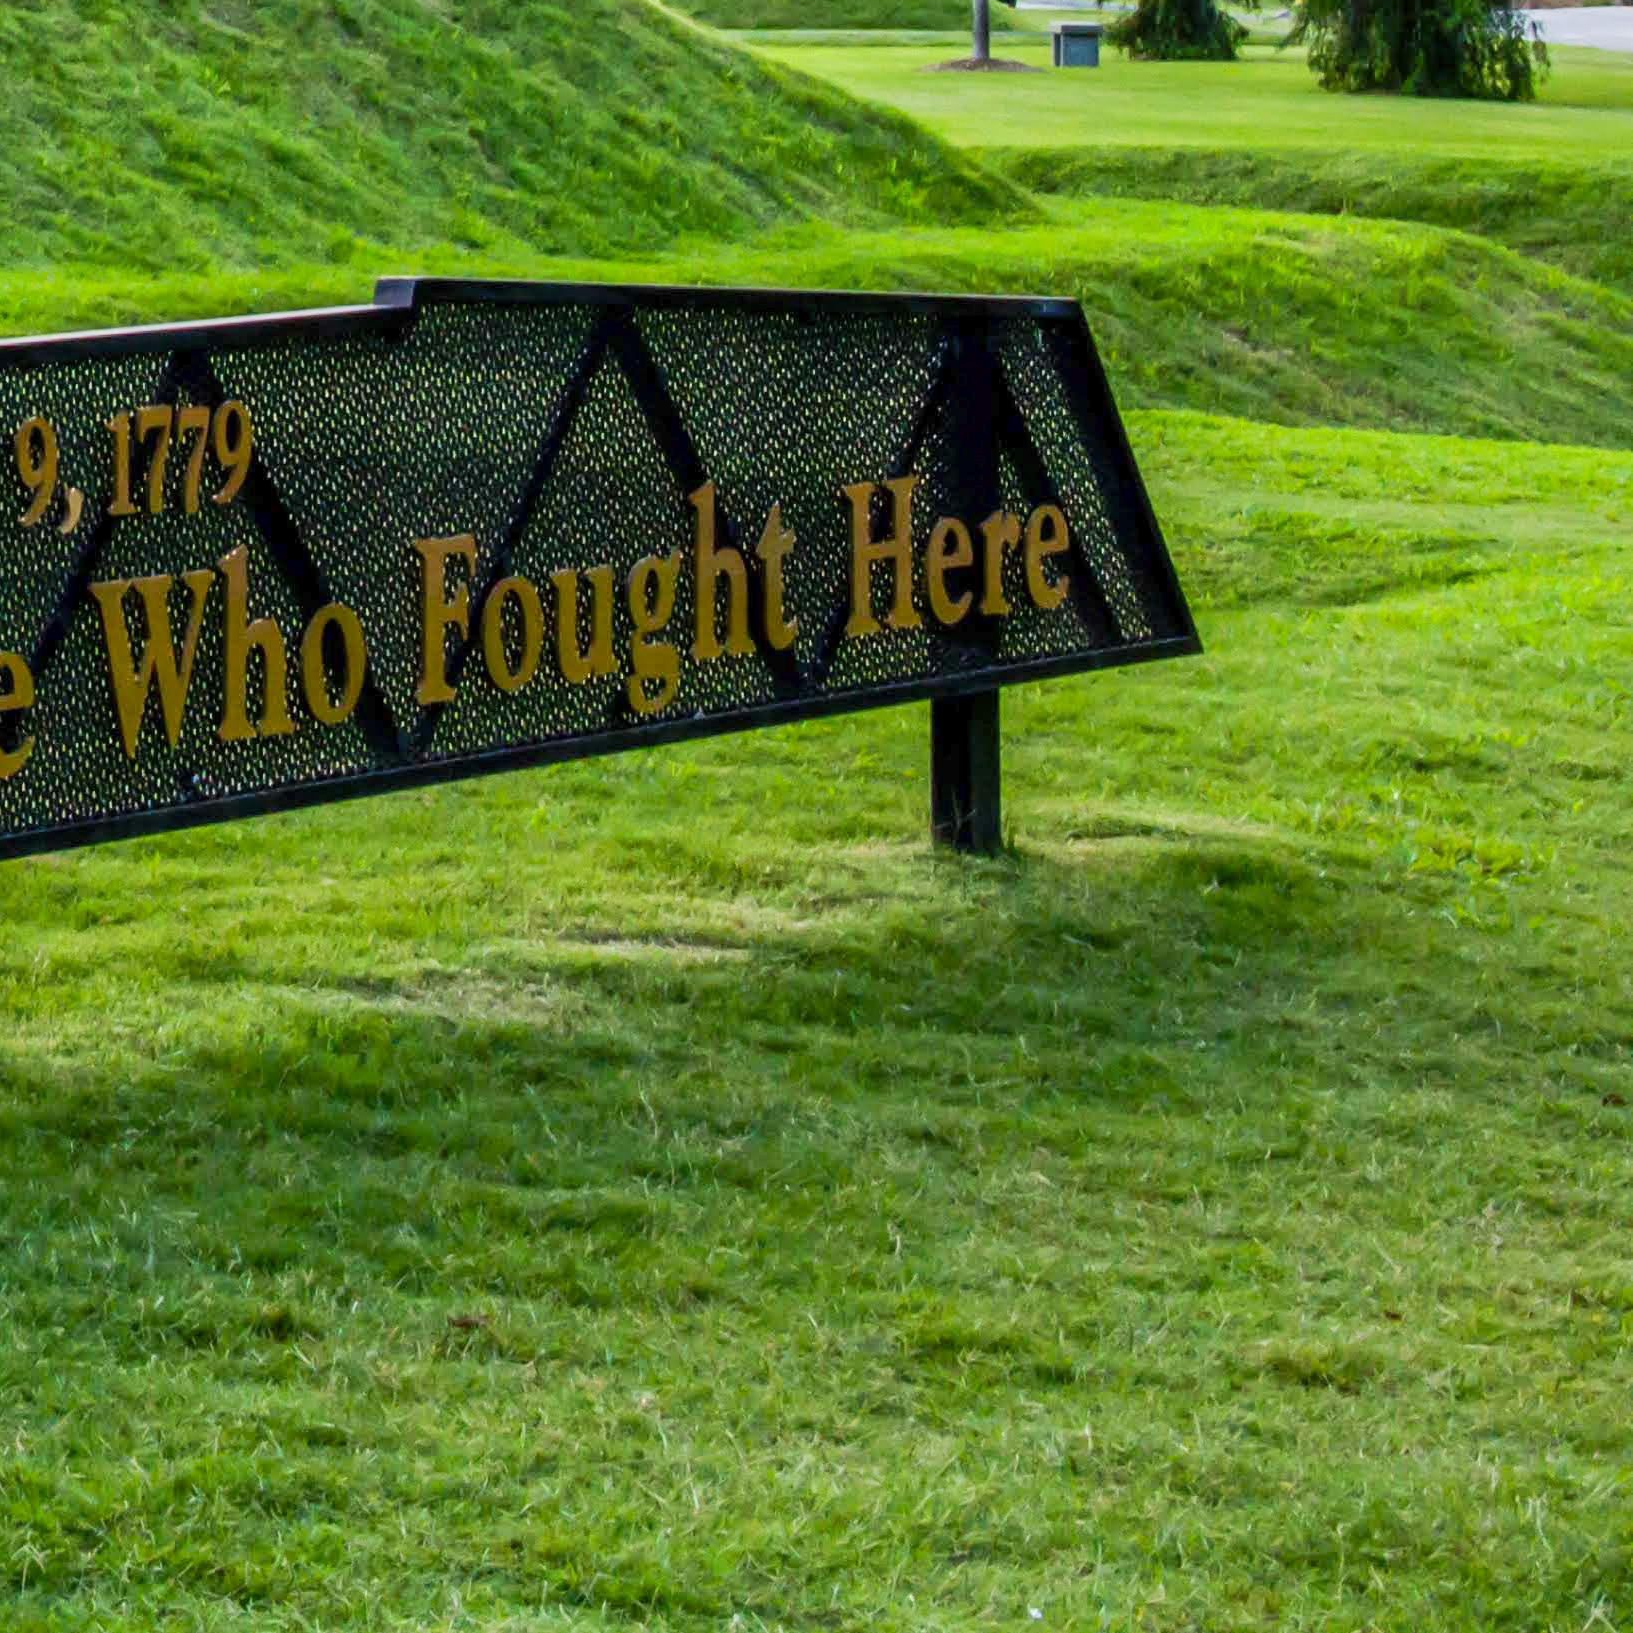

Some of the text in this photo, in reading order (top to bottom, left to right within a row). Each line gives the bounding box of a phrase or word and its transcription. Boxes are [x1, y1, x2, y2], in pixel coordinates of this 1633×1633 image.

[15, 416, 86, 535] 9,
[108, 397, 254, 516] 1779
[89, 544, 368, 759] Who
[411, 479, 797, 715] Fought
[843, 473, 1071, 638] Here
